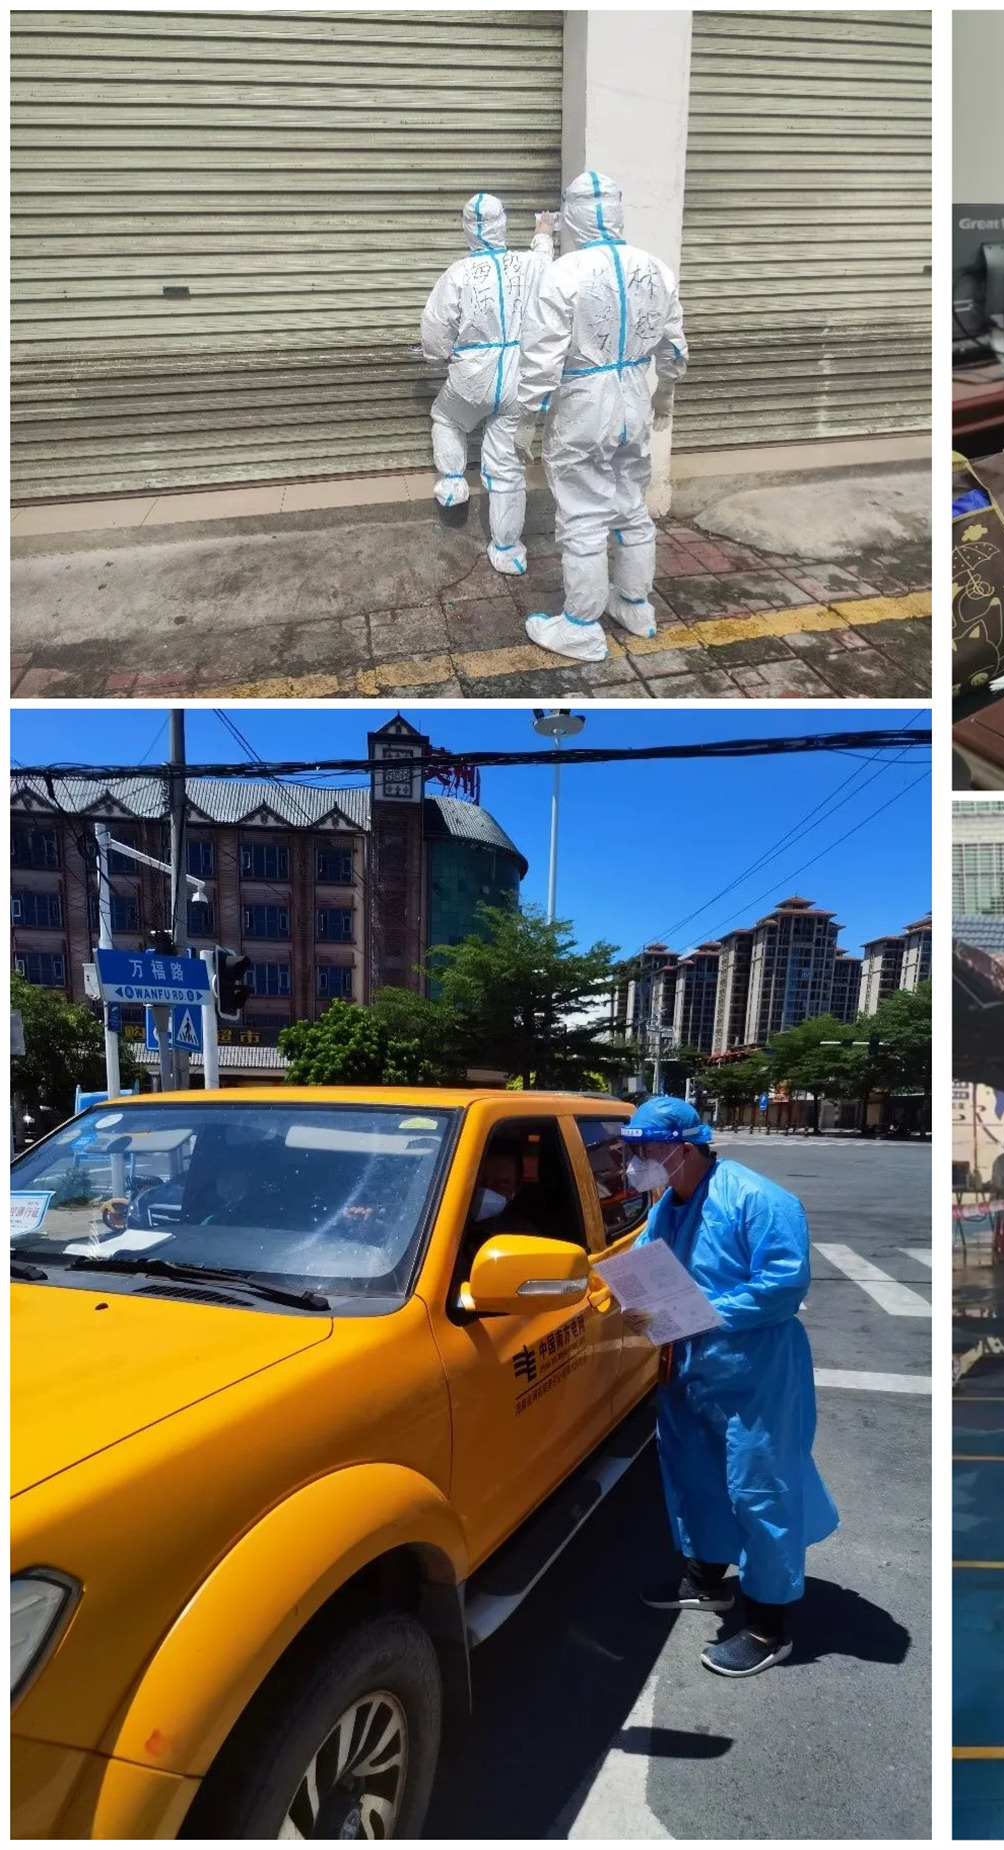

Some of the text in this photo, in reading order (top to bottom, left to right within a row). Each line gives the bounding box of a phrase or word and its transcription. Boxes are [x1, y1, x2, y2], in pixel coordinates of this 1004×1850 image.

[959, 217, 999, 230] Great
[128, 959, 184, 982] 万福路
[134, 988, 171, 1001] WANFU
